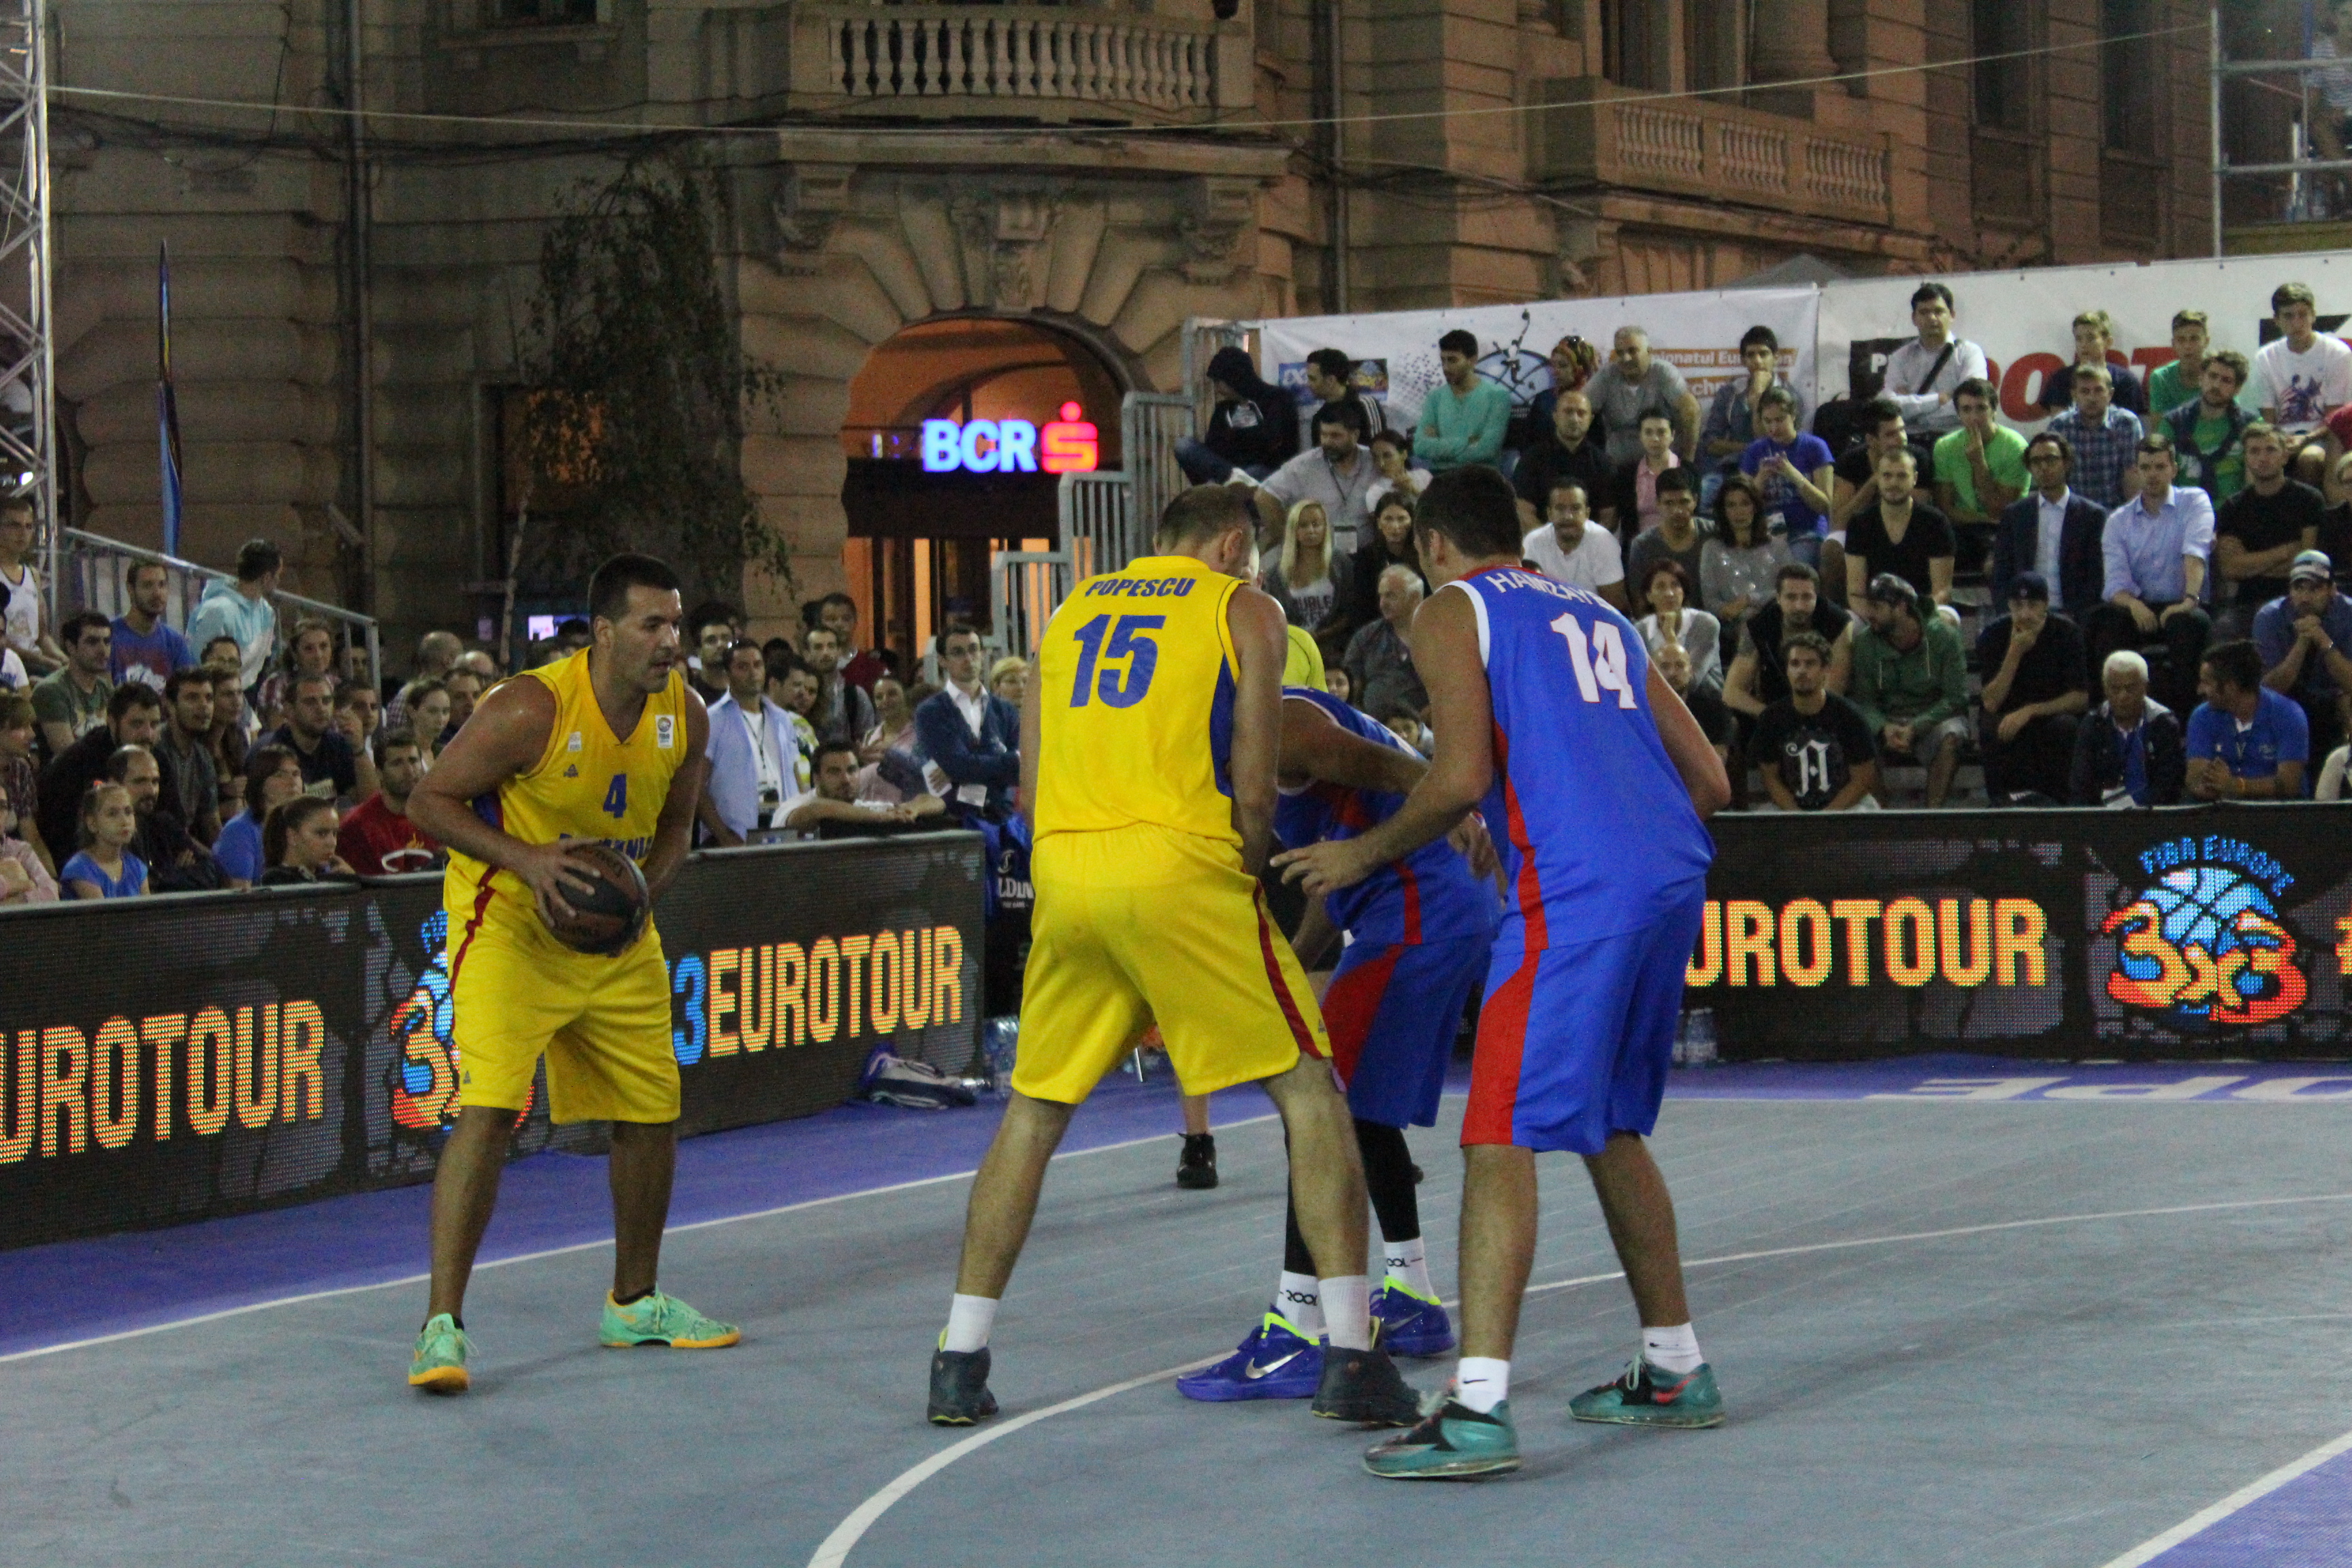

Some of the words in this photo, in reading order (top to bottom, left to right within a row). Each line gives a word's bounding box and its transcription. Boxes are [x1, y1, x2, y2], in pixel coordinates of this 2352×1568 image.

[923, 419, 1038, 472] BCR
[1085, 577, 1197, 598] POPESCU
[1070, 614, 1166, 709] 15
[1550, 612, 1637, 709] 14
[603, 773, 627, 819] 4
[668, 926, 963, 1066] 3EUROTOUR
